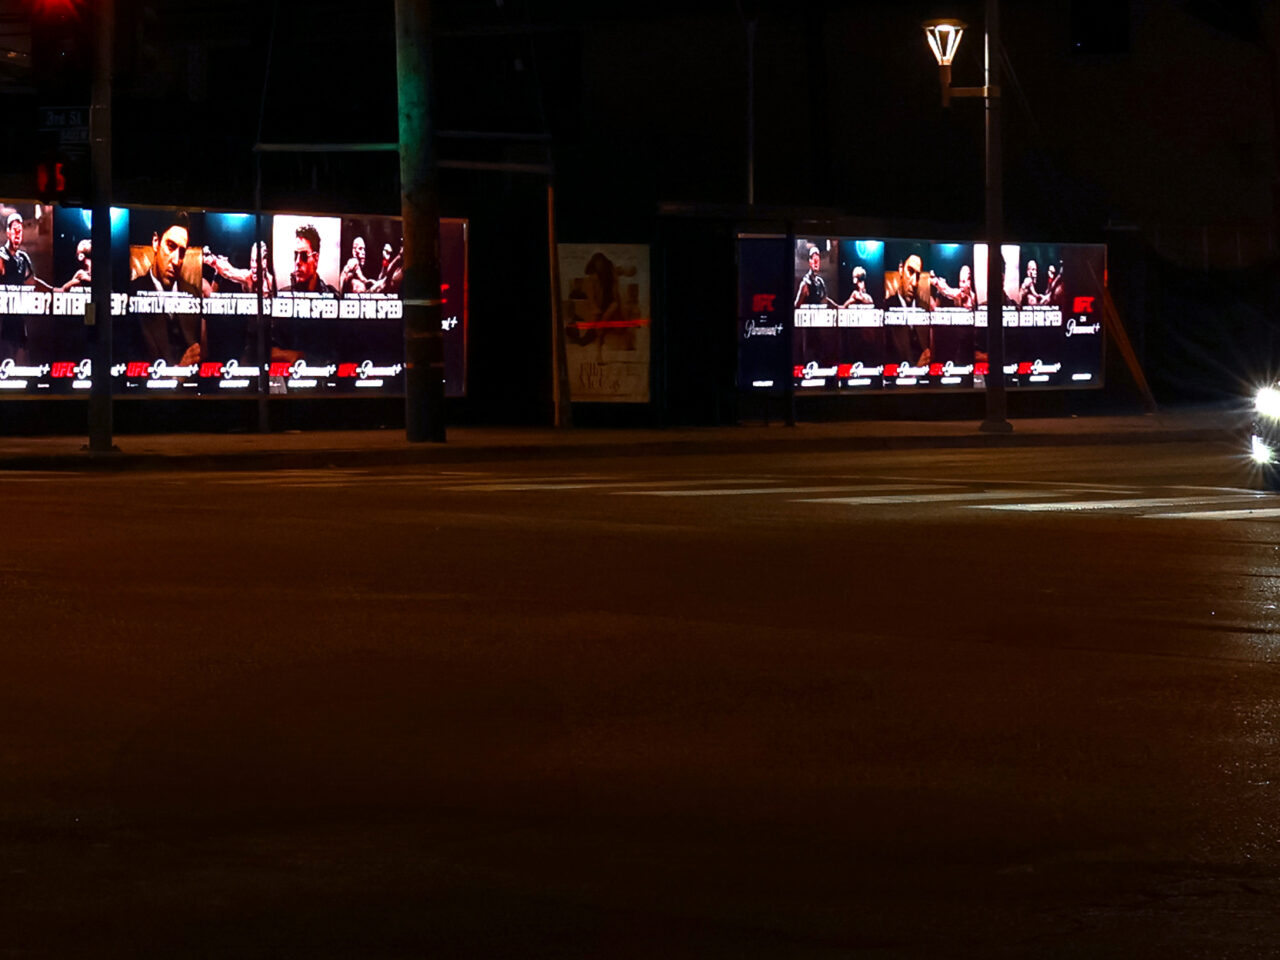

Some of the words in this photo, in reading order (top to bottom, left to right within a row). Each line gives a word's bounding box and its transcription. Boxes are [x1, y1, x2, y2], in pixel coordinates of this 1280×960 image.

[129, 296, 164, 313] STRICTLY
[164, 297, 201, 314] BUSINESS
[202, 297, 237, 315] STRICTLY
[272, 298, 293, 317] NEED
[293, 299, 311, 318] FOR
[311, 299, 338, 318] SPEED
[339, 300, 360, 318] NEED
[360, 300, 377, 318] FOR
[377, 300, 403, 318] SPEED
[51, 362, 76, 377] UFC
[127, 362, 150, 376] UFC
[200, 362, 223, 377] UFC
